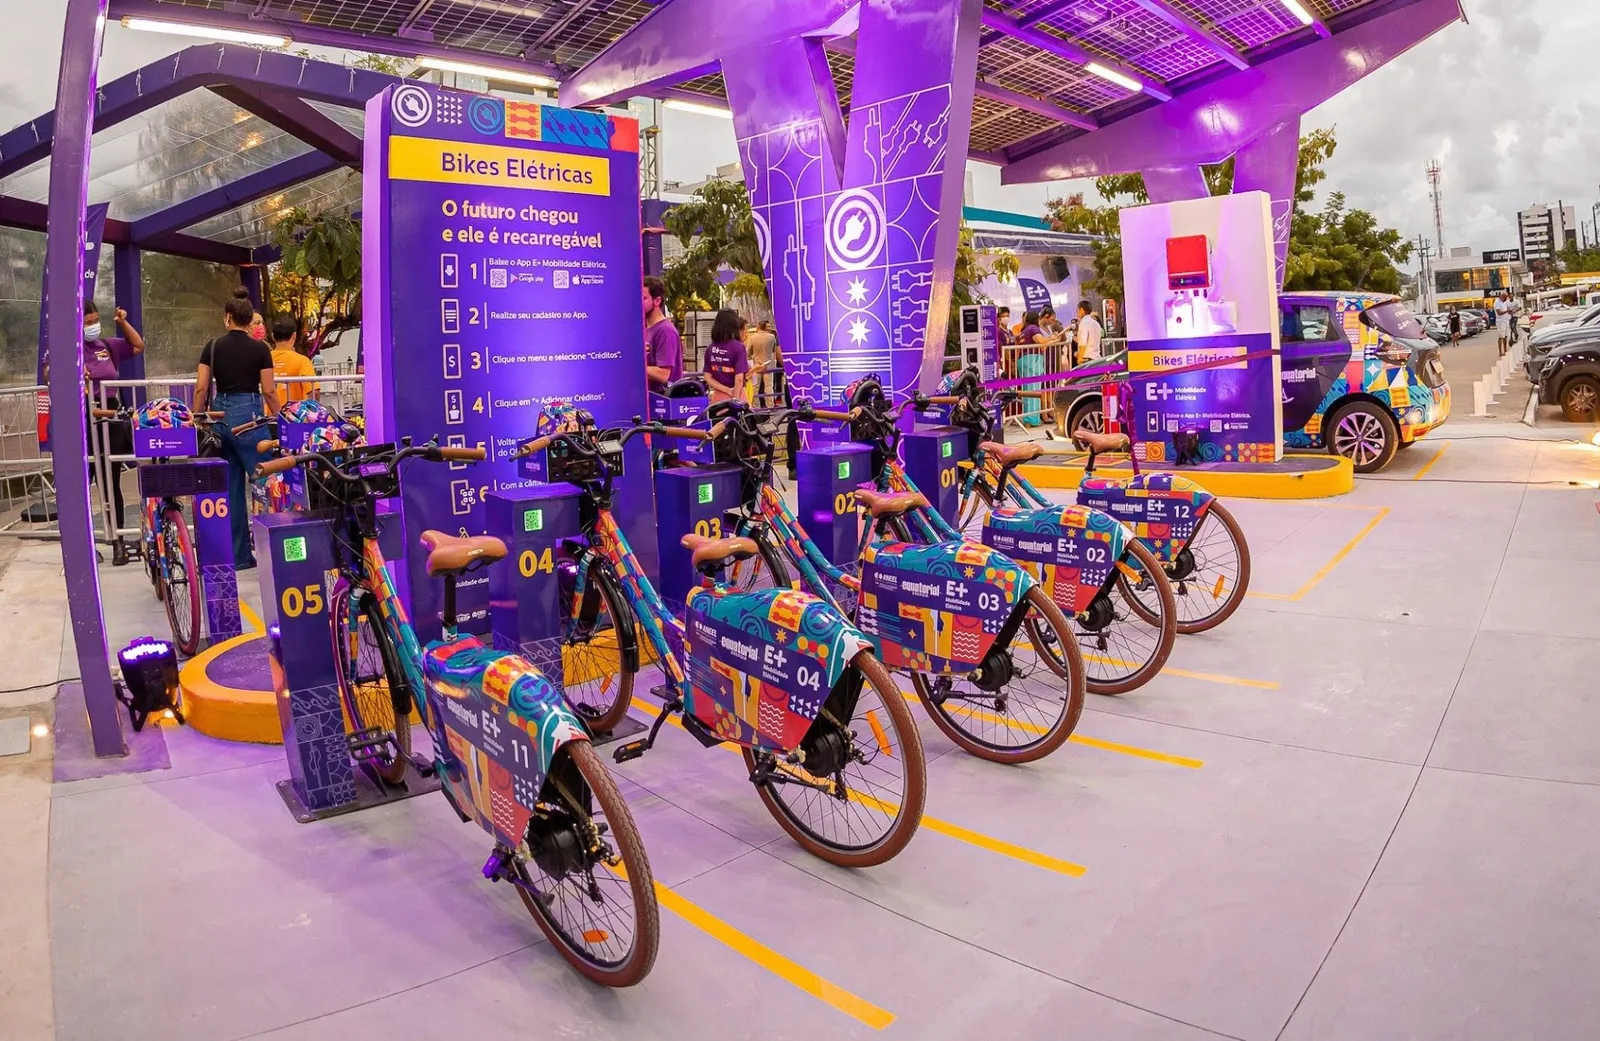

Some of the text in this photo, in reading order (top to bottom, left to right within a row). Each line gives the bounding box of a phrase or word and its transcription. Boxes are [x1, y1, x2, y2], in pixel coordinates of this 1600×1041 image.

[441, 152, 593, 184] Bikes Elétricas
[442, 200, 578, 225] O futuro chegou
[442, 226, 602, 250] e ele é recarregável
[470, 263, 478, 280] 1
[489, 258, 509, 266] Baixe
[516, 259, 532, 268] App
[542, 259, 580, 268] Mobilidade
[1026, 286, 1046, 299] E+
[468, 308, 480, 324] 2
[490, 311, 516, 319] Realize
[532, 311, 562, 319] cadastro
[573, 311, 588, 320] App.
[470, 352, 482, 370] 3
[492, 355, 516, 364] Clique
[554, 352, 586, 361] selecione
[1154, 356, 1183, 366] Bikes
[1280, 368, 1316, 380] quatorial
[1146, 382, 1174, 400] E+
[472, 397, 484, 414] 4
[494, 399, 518, 408] Clique
[149, 438, 164, 449] E+
[496, 438, 516, 446] Volte
[500, 482, 518, 490] Com
[941, 468, 956, 488] 01
[200, 498, 228, 518] 06
[834, 492, 856, 515] 02
[1147, 499, 1165, 512] E+
[1174, 505, 1190, 518] 12
[694, 517, 722, 540] 03
[1018, 540, 1052, 552] equatorial
[1057, 538, 1078, 553] E+
[1086, 547, 1106, 563] 02
[518, 548, 554, 578] 04
[281, 584, 324, 618] 05
[902, 580, 940, 596] equatorial
[946, 580, 968, 598] E+
[978, 592, 1000, 612] 03
[946, 596, 970, 606] Mobilidade
[721, 636, 758, 662] equatorial
[764, 644, 787, 668] E+
[796, 666, 820, 692] 04
[763, 664, 788, 680] Mobilidade
[482, 710, 501, 738] E+
[512, 740, 529, 769] 11
